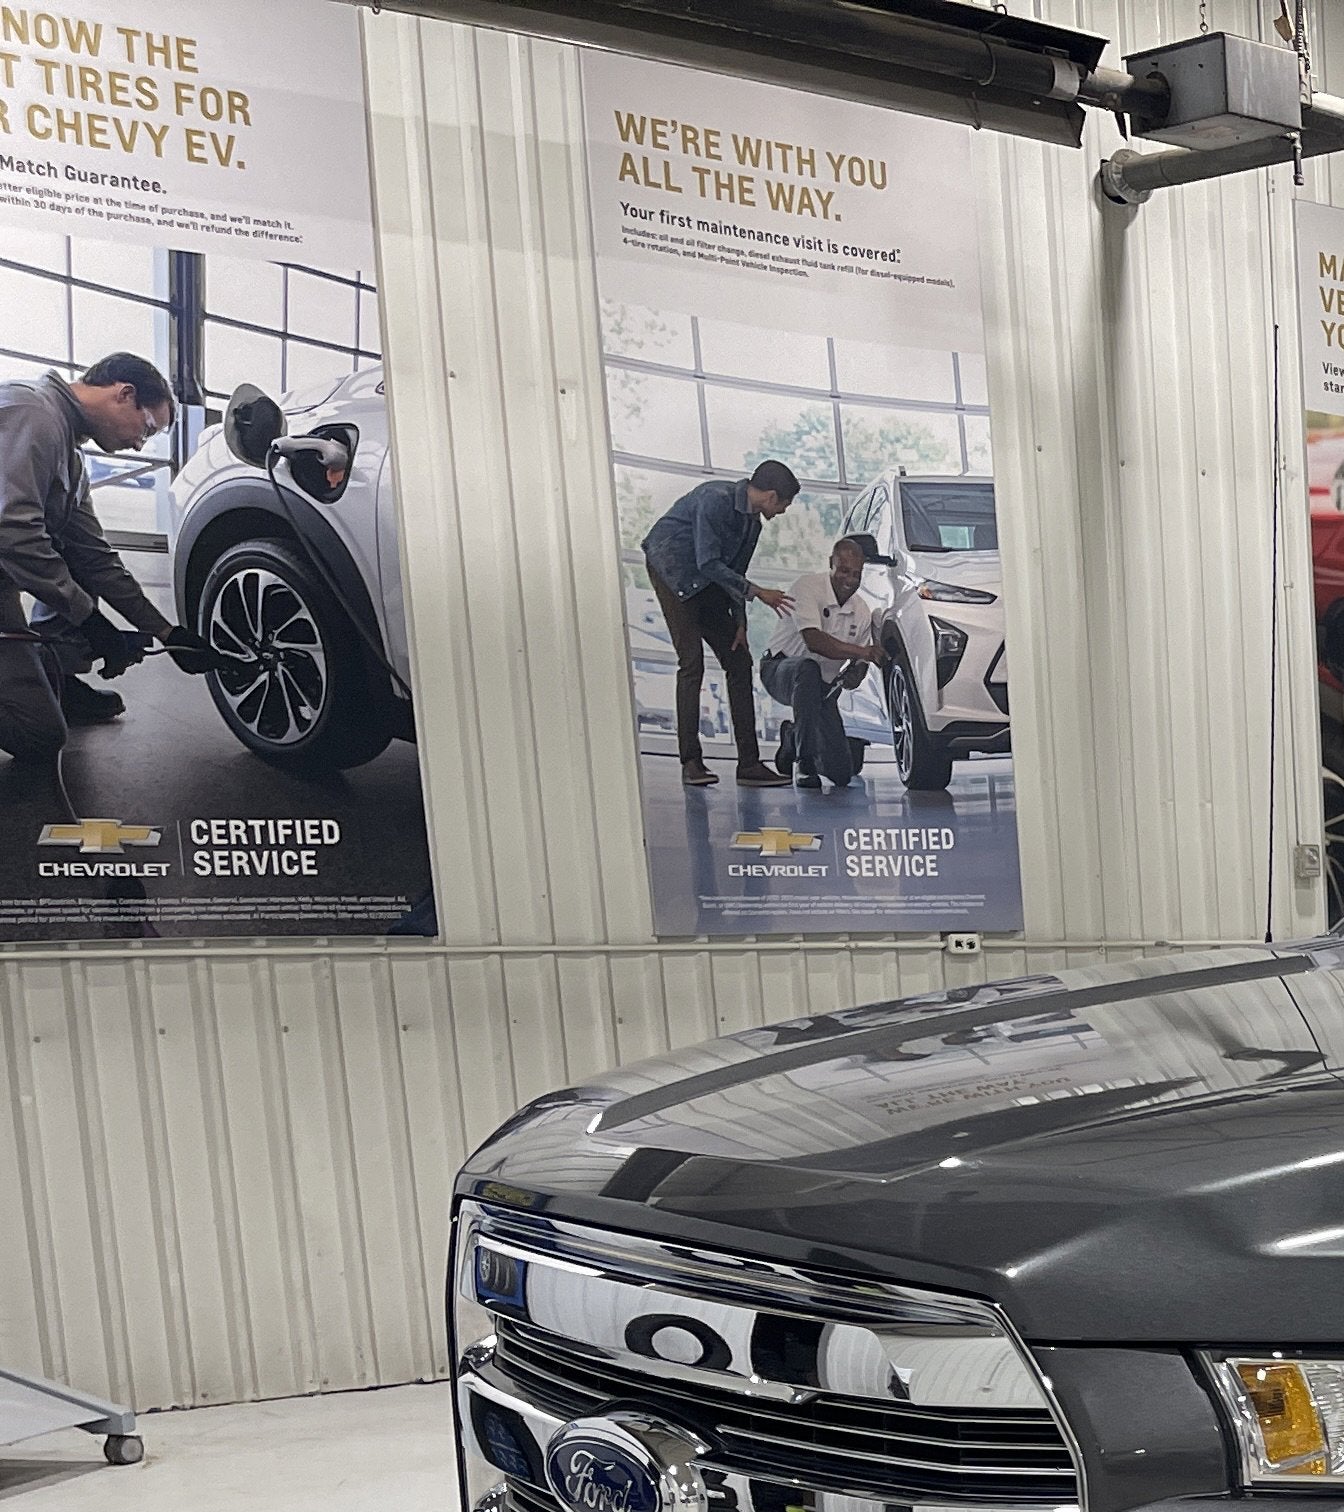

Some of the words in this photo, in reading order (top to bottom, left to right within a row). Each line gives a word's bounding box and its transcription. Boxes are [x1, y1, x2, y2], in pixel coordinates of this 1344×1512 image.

[116, 26, 199, 74] THE
[35, 58, 159, 112] TIRES
[173, 82, 252, 127] FOR
[27, 104, 170, 159] CHEVY
[185, 128, 246, 170] EV.
[614, 110, 723, 161] WE'RE
[731, 133, 816, 179] WITH
[826, 151, 887, 190] YOU
[0, 154, 58, 178] Match
[64, 164, 167, 195] Guarantee.
[618, 152, 683, 194] ALL
[691, 165, 756, 207] THE
[764, 179, 842, 222] WAY.
[26, 187, 62, 198] eligible
[65, 192, 90, 203] price
[106, 198, 122, 208] the
[125, 200, 146, 211] time
[149, 203, 159, 213] of
[210, 213, 227, 222] and
[253, 218, 282, 228] match
[34, 200, 46, 209] 30
[49, 202, 72, 214] days
[75, 206, 86, 216] of
[87, 208, 104, 218] the
[157, 219, 174, 228] and
[201, 223, 232, 235] refund
[235, 228, 250, 237] the
[620, 201, 655, 221] Your
[659, 209, 692, 229] first
[697, 219, 790, 247] maintenance
[793, 235, 823, 253] visit
[827, 238, 839, 254] is
[190, 818, 341, 846] CERTIFIED
[843, 828, 954, 850] CERTIFIED
[38, 862, 171, 878] CHEVROLET
[193, 850, 318, 877] SERVICE
[728, 864, 828, 877] CHEVROLET
[846, 855, 939, 877] SERVICE
